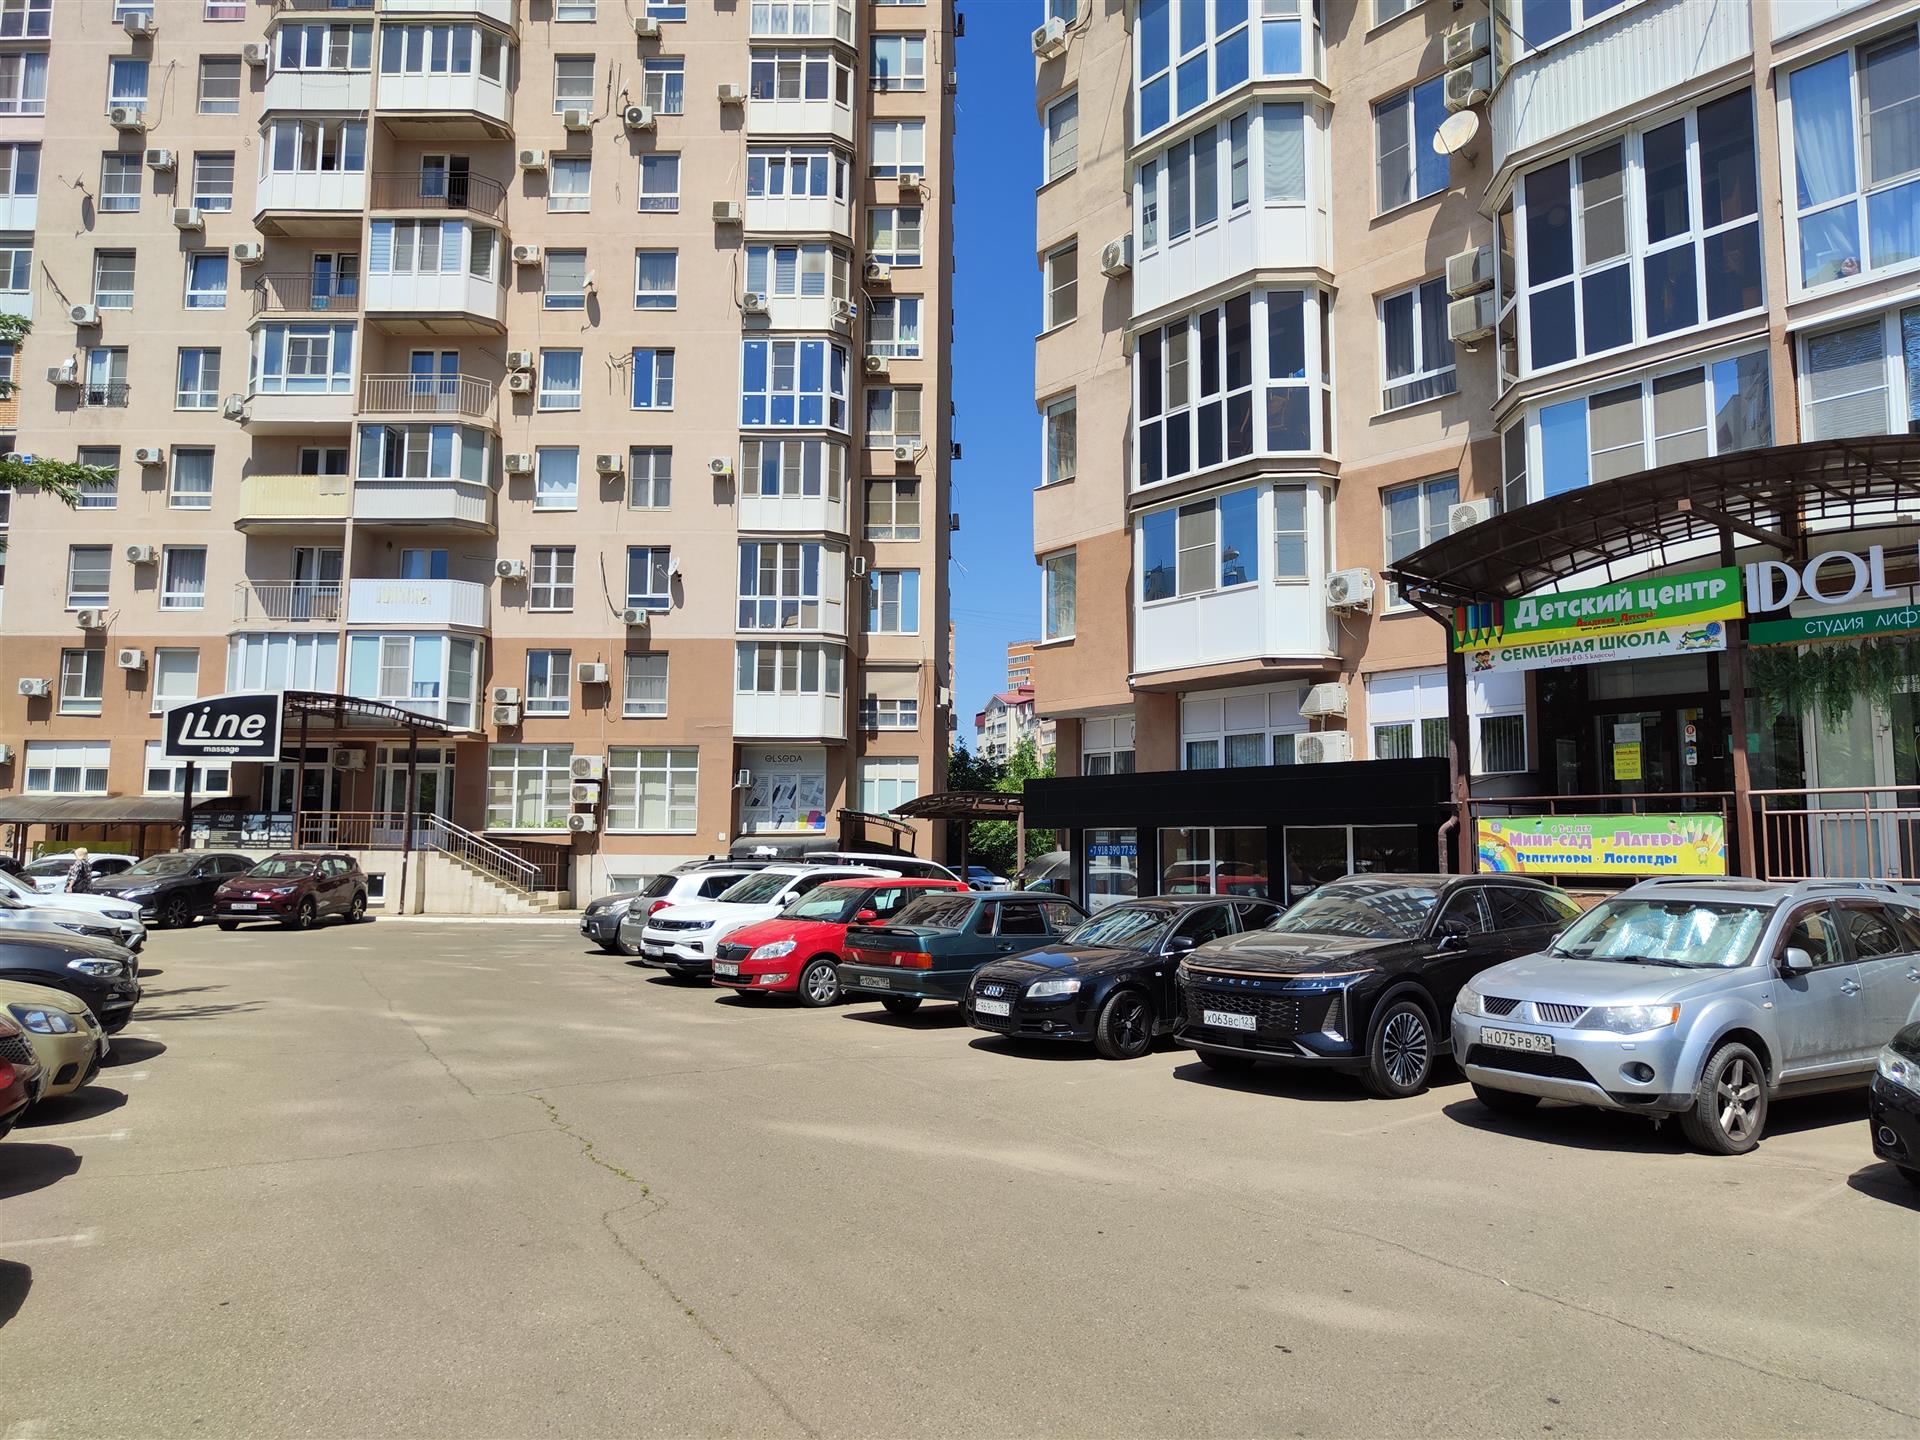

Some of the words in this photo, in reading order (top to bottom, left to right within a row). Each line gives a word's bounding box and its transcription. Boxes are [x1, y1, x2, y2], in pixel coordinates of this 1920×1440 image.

[1514, 588, 1634, 630] Детский
[1804, 616, 1864, 636] студия
[1875, 606, 1920, 628] лиф
[1599, 630, 1671, 651] ШКОЛА
[203, 746, 240, 754] massage
[1097, 845, 1108, 855] 918
[1108, 845, 1120, 855] 390
[1120, 845, 1128, 855] 77
[1129, 845, 1137, 855] 36
[1206, 976, 1261, 987] EXEED
[1240, 1016, 1254, 1026] 123
[1486, 1031, 1532, 1048] Н075РВ
[1534, 1035, 1547, 1047] 93
